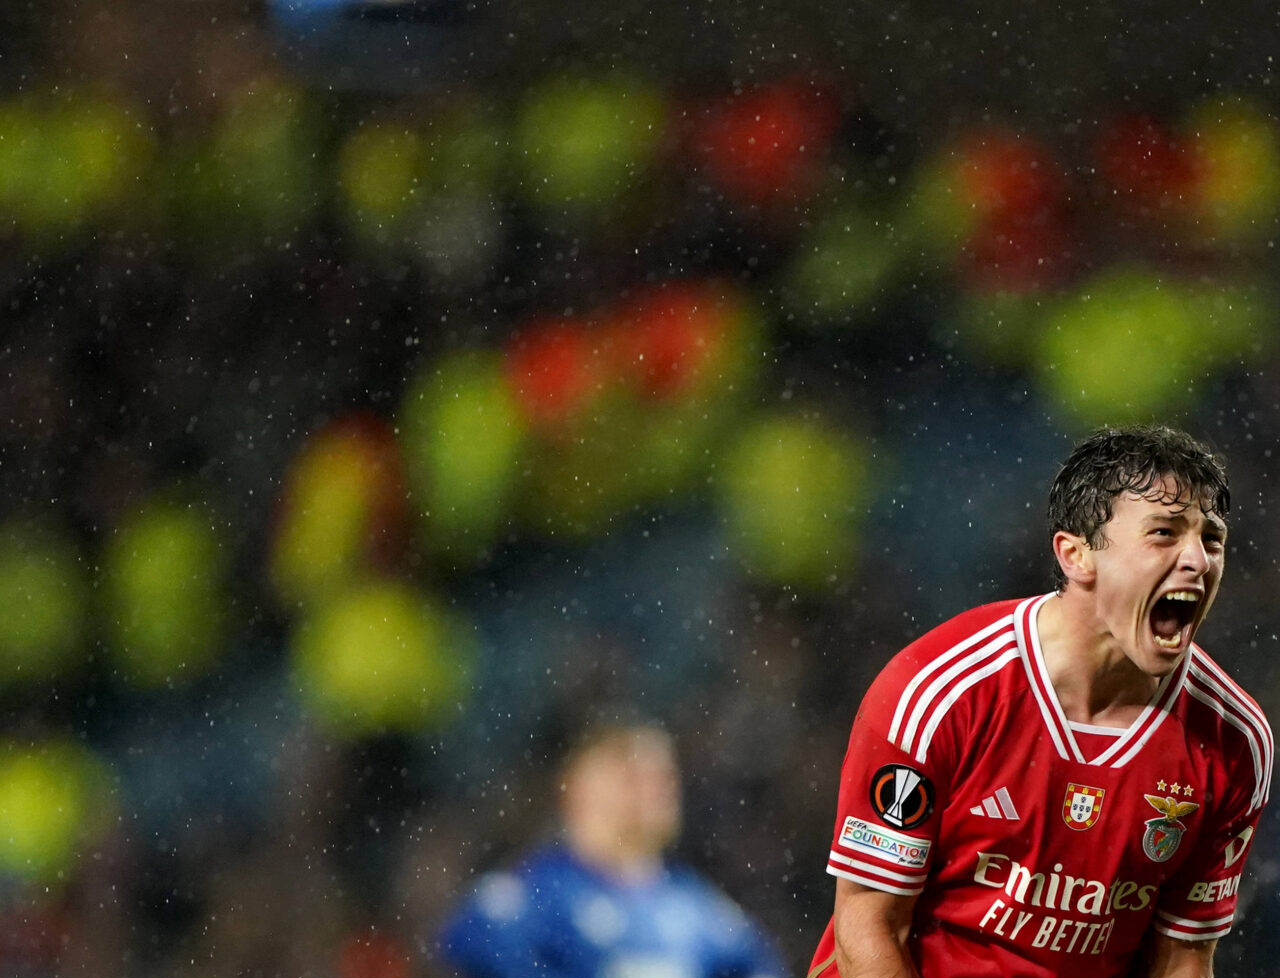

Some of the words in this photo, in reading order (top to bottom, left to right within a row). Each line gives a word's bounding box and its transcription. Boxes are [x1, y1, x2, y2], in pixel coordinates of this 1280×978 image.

[847, 819, 867, 831] UEFA
[974, 850, 1158, 916] Emirates
[979, 899, 1034, 941] FLY
